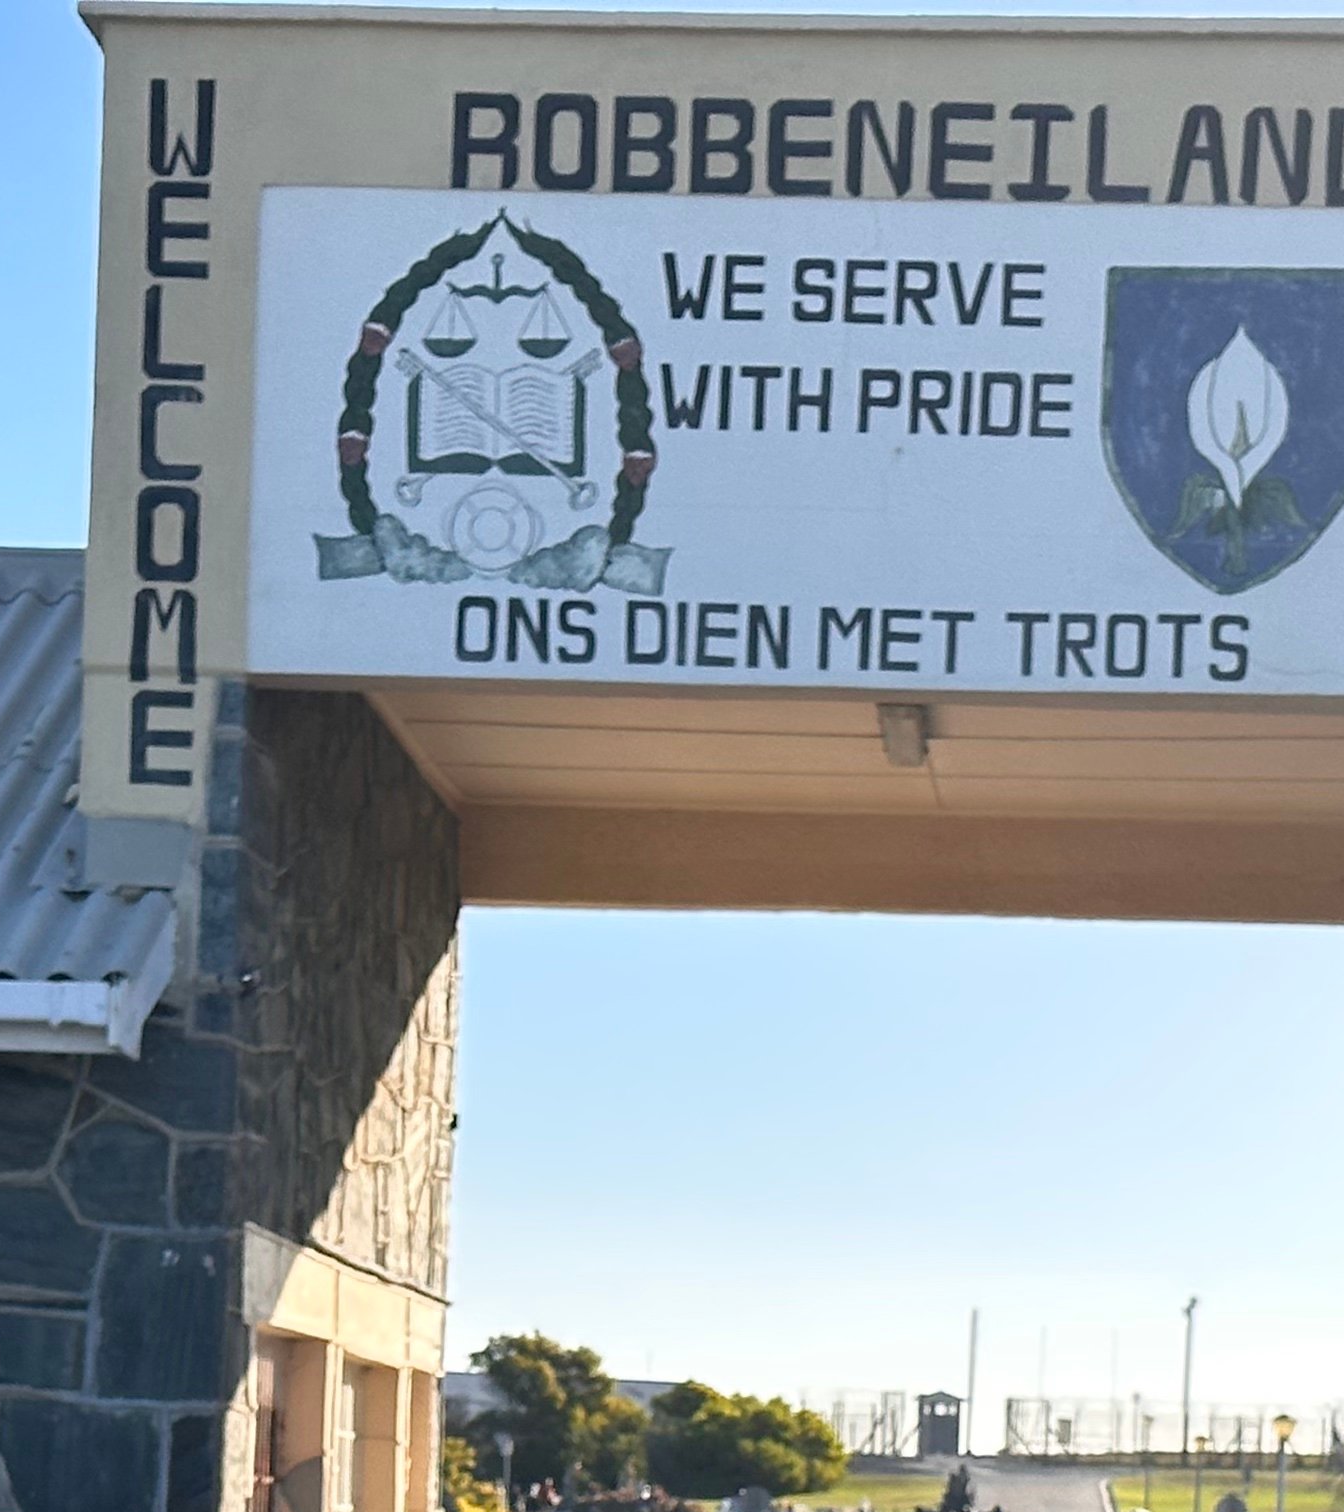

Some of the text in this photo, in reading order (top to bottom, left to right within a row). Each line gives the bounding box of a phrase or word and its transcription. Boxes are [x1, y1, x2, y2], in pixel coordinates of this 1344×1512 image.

[662, 252, 1046, 327] WE SERVE
[128, 78, 216, 787] WELCOME
[662, 364, 1074, 438] WITH PRIDE
[456, 596, 1250, 682] ONS DIEN MET TROTS
